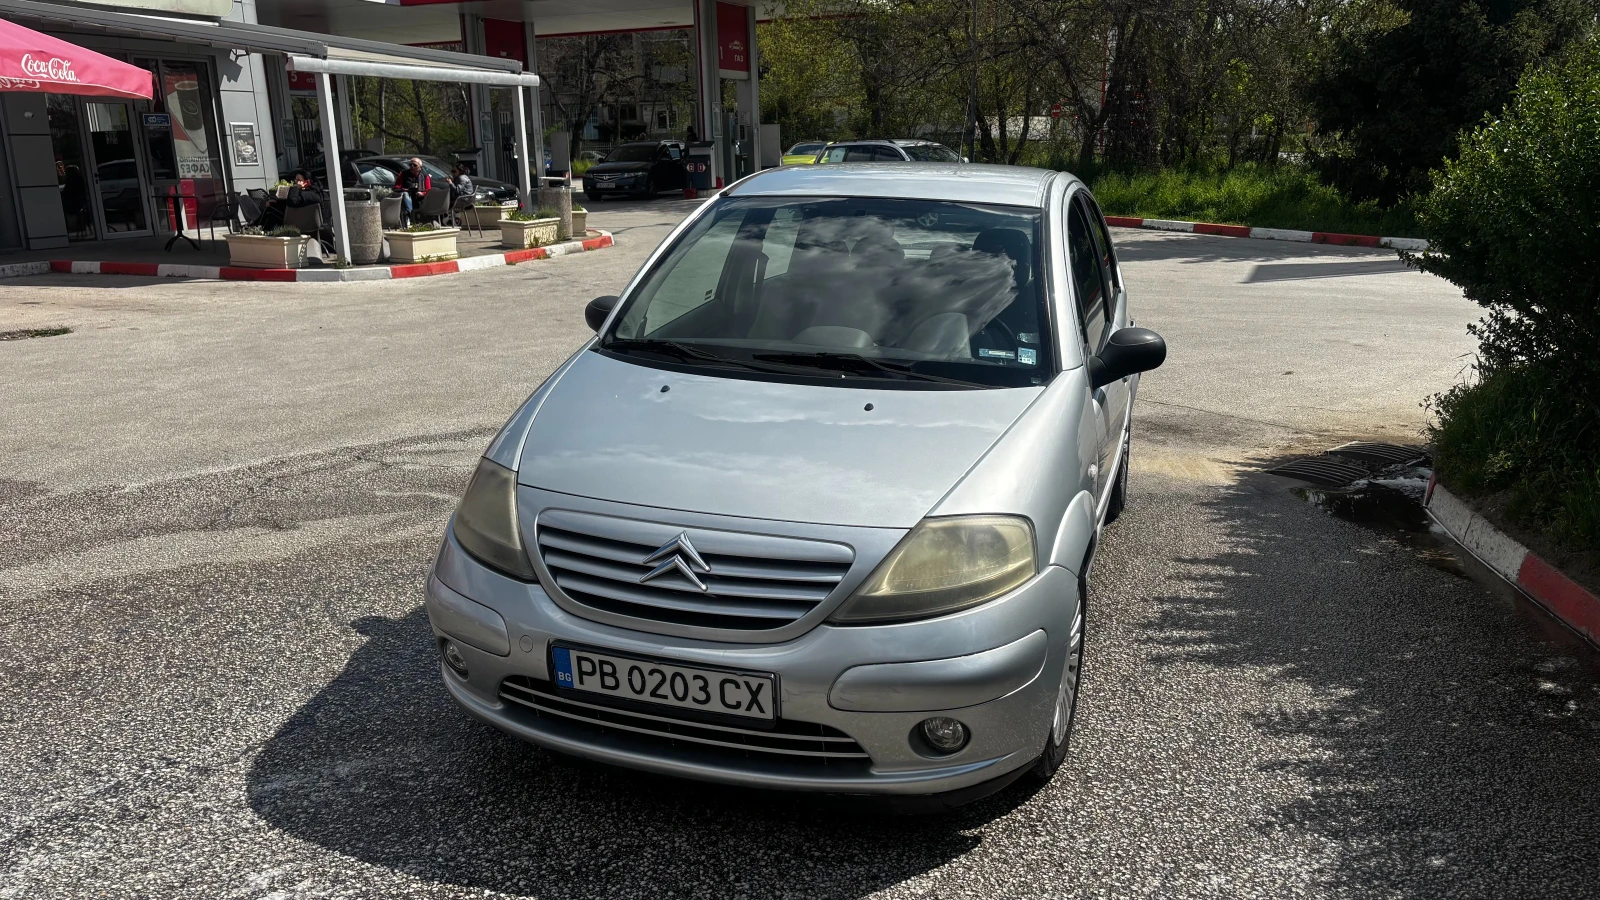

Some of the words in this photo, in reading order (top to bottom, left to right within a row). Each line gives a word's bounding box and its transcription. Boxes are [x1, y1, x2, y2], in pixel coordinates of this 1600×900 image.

[734, 54, 744, 62] ГАЗ
[21, 53, 78, 81] Coca-Cola
[290, 71, 298, 82] 5
[557, 671, 572, 682] BG
[576, 655, 620, 691] PB
[627, 665, 711, 705] 0203
[719, 678, 766, 714] CX
